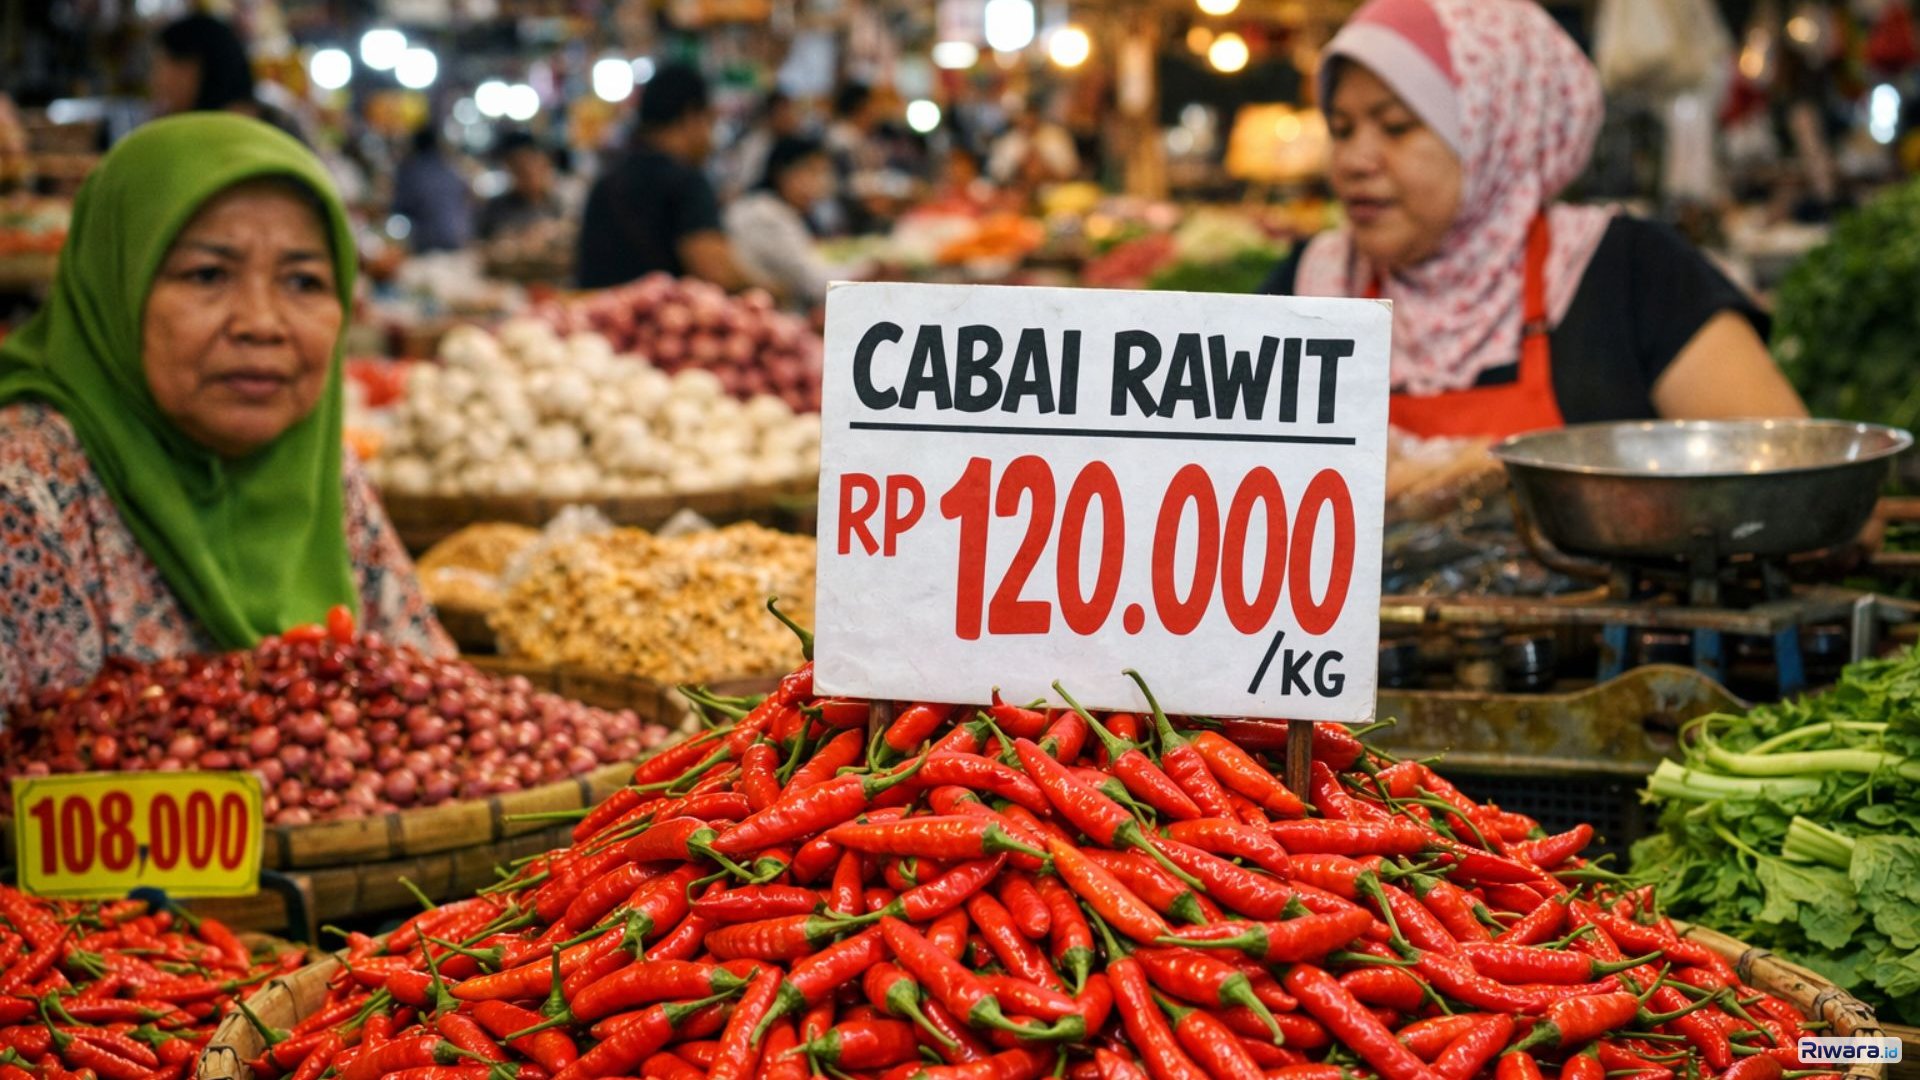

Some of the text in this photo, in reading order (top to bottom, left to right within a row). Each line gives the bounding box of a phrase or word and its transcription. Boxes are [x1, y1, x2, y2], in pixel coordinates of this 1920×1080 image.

[853, 321, 1356, 424] CABAI RAWIT
[837, 454, 1357, 641] RP 120.000
[1247, 630, 1346, 698] /KG
[28, 789, 249, 879] 108,000
